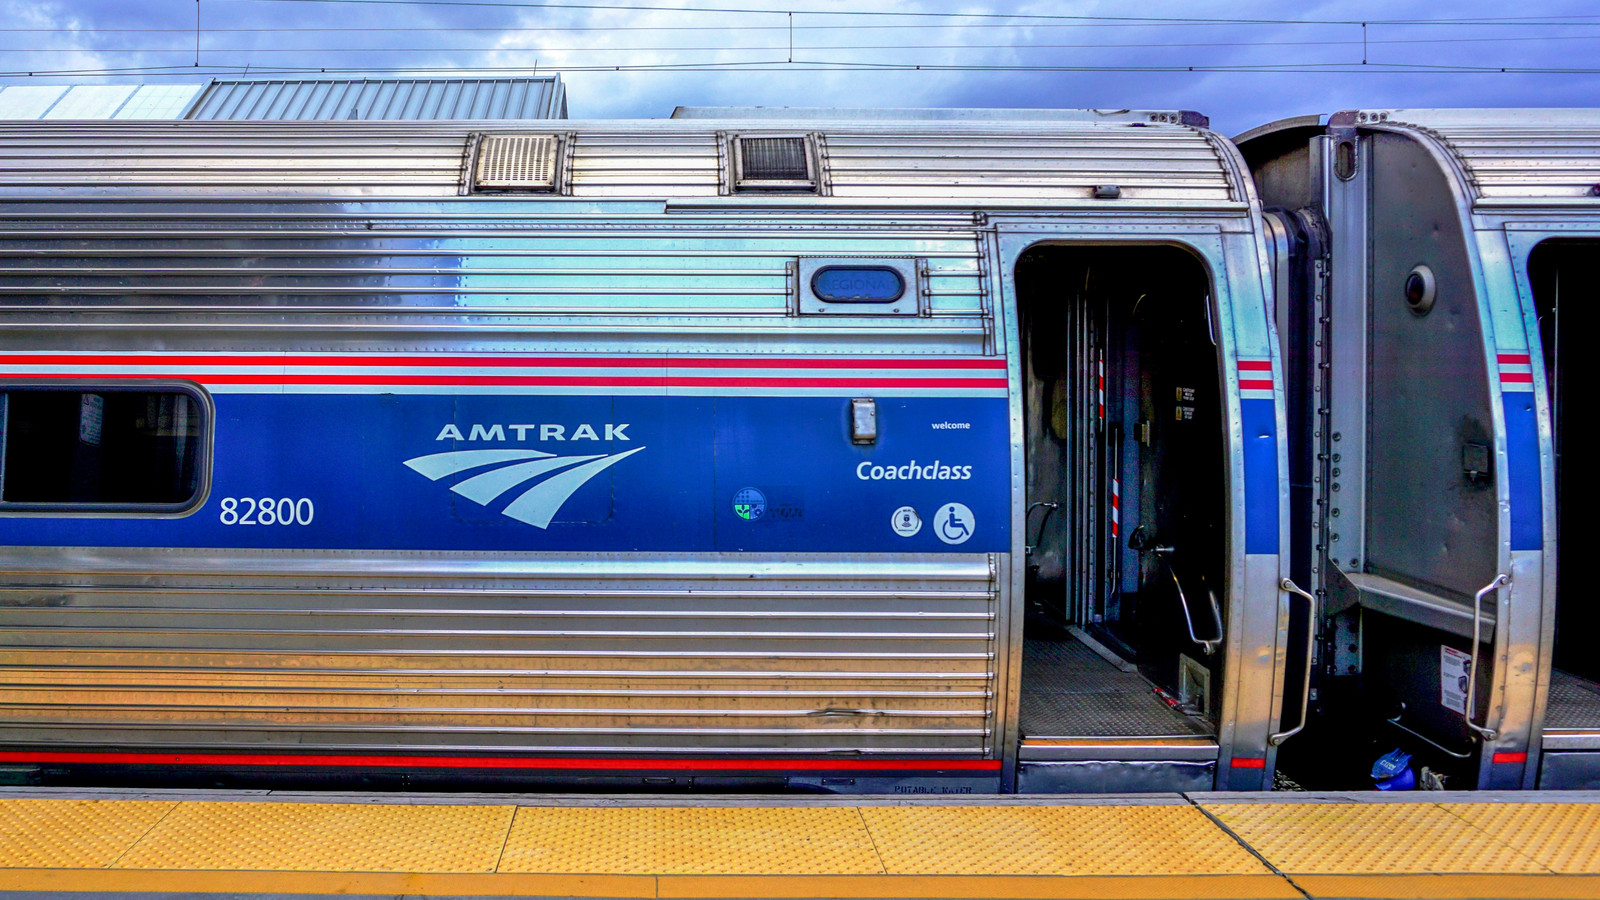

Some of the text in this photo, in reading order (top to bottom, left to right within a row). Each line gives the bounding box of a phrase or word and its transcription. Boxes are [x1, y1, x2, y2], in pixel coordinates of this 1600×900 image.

[435, 423, 631, 441] AMTRAK
[931, 421, 971, 430] welcome
[856, 460, 973, 480] Coachclass
[219, 497, 315, 526] 82800
